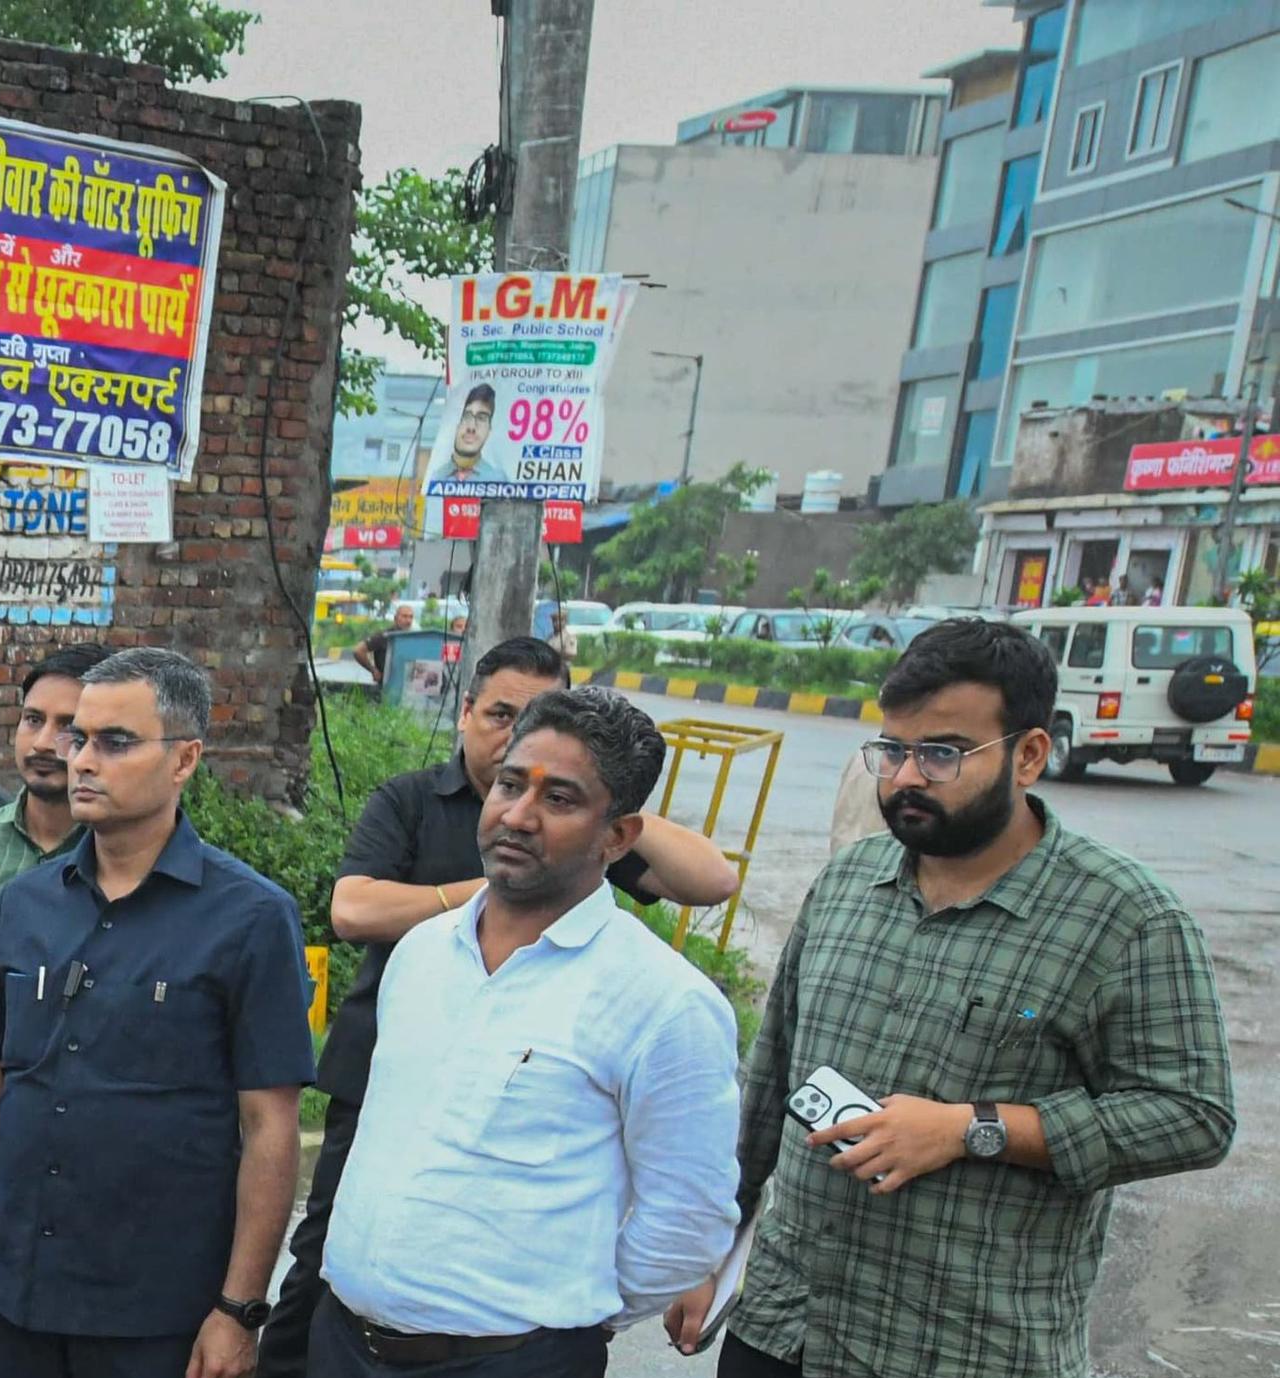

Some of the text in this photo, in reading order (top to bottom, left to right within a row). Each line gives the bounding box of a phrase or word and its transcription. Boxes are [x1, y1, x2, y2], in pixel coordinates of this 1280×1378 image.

[48, 154, 82, 224] की
[49, 242, 83, 267] और
[5, 247, 34, 314] से
[460, 275, 609, 322] I.G.M.
[512, 323, 553, 336] Public
[557, 323, 605, 338] School
[0, 334, 72, 369] रवि गुप्ता
[500, 367, 543, 379] GROUP
[546, 367, 563, 379] TO
[48, 363, 182, 416] एक्सपर्ट
[517, 382, 591, 395] Congratulates
[507, 397, 590, 444] 98%
[525, 445, 581, 459] X Class
[112, 472, 145, 485] TO-LET
[516, 460, 583, 481] ISHAN
[431, 481, 583, 500] ADMISSION OPEN
